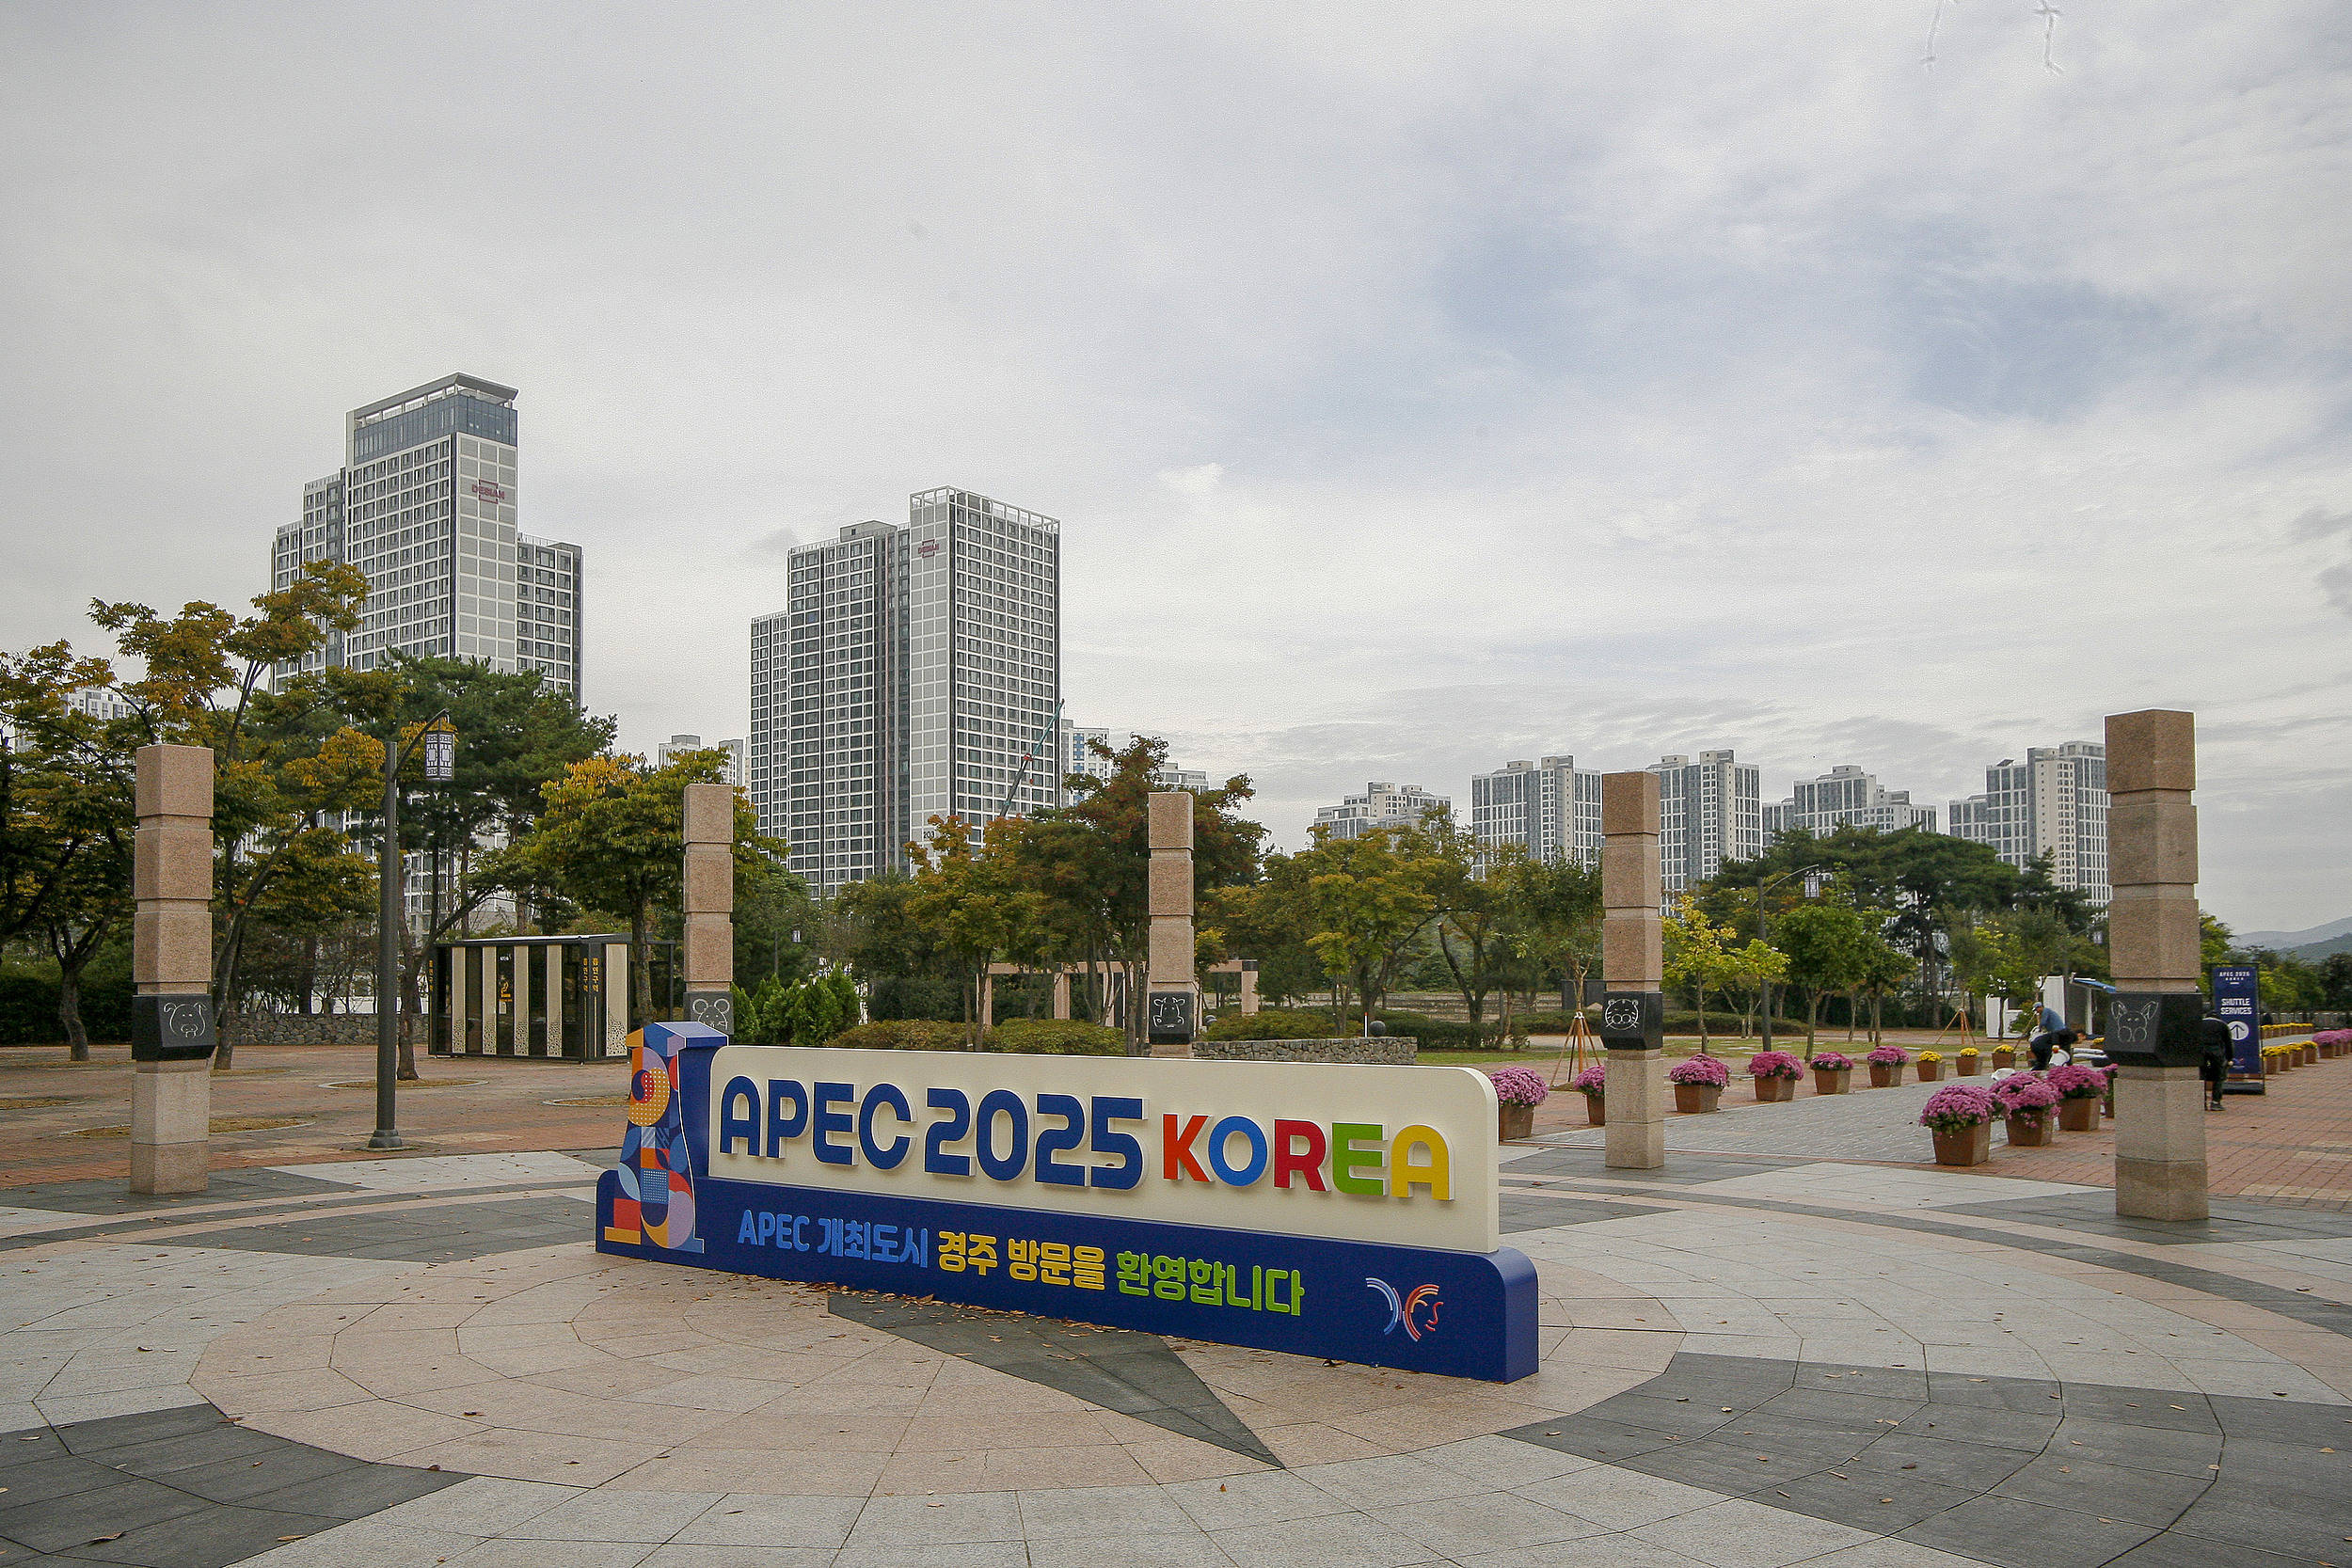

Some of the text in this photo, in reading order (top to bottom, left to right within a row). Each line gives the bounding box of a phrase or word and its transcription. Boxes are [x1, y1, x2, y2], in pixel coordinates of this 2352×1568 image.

[2220, 1006, 2252, 1015] SERVICES
[2221, 998, 2250, 1006] SHUTTLE
[720, 1075, 1454, 1200] APEC 2025 KOREA
[738, 1210, 1305, 1316] APEC 개최도시 경주 방문을 환영합니다
